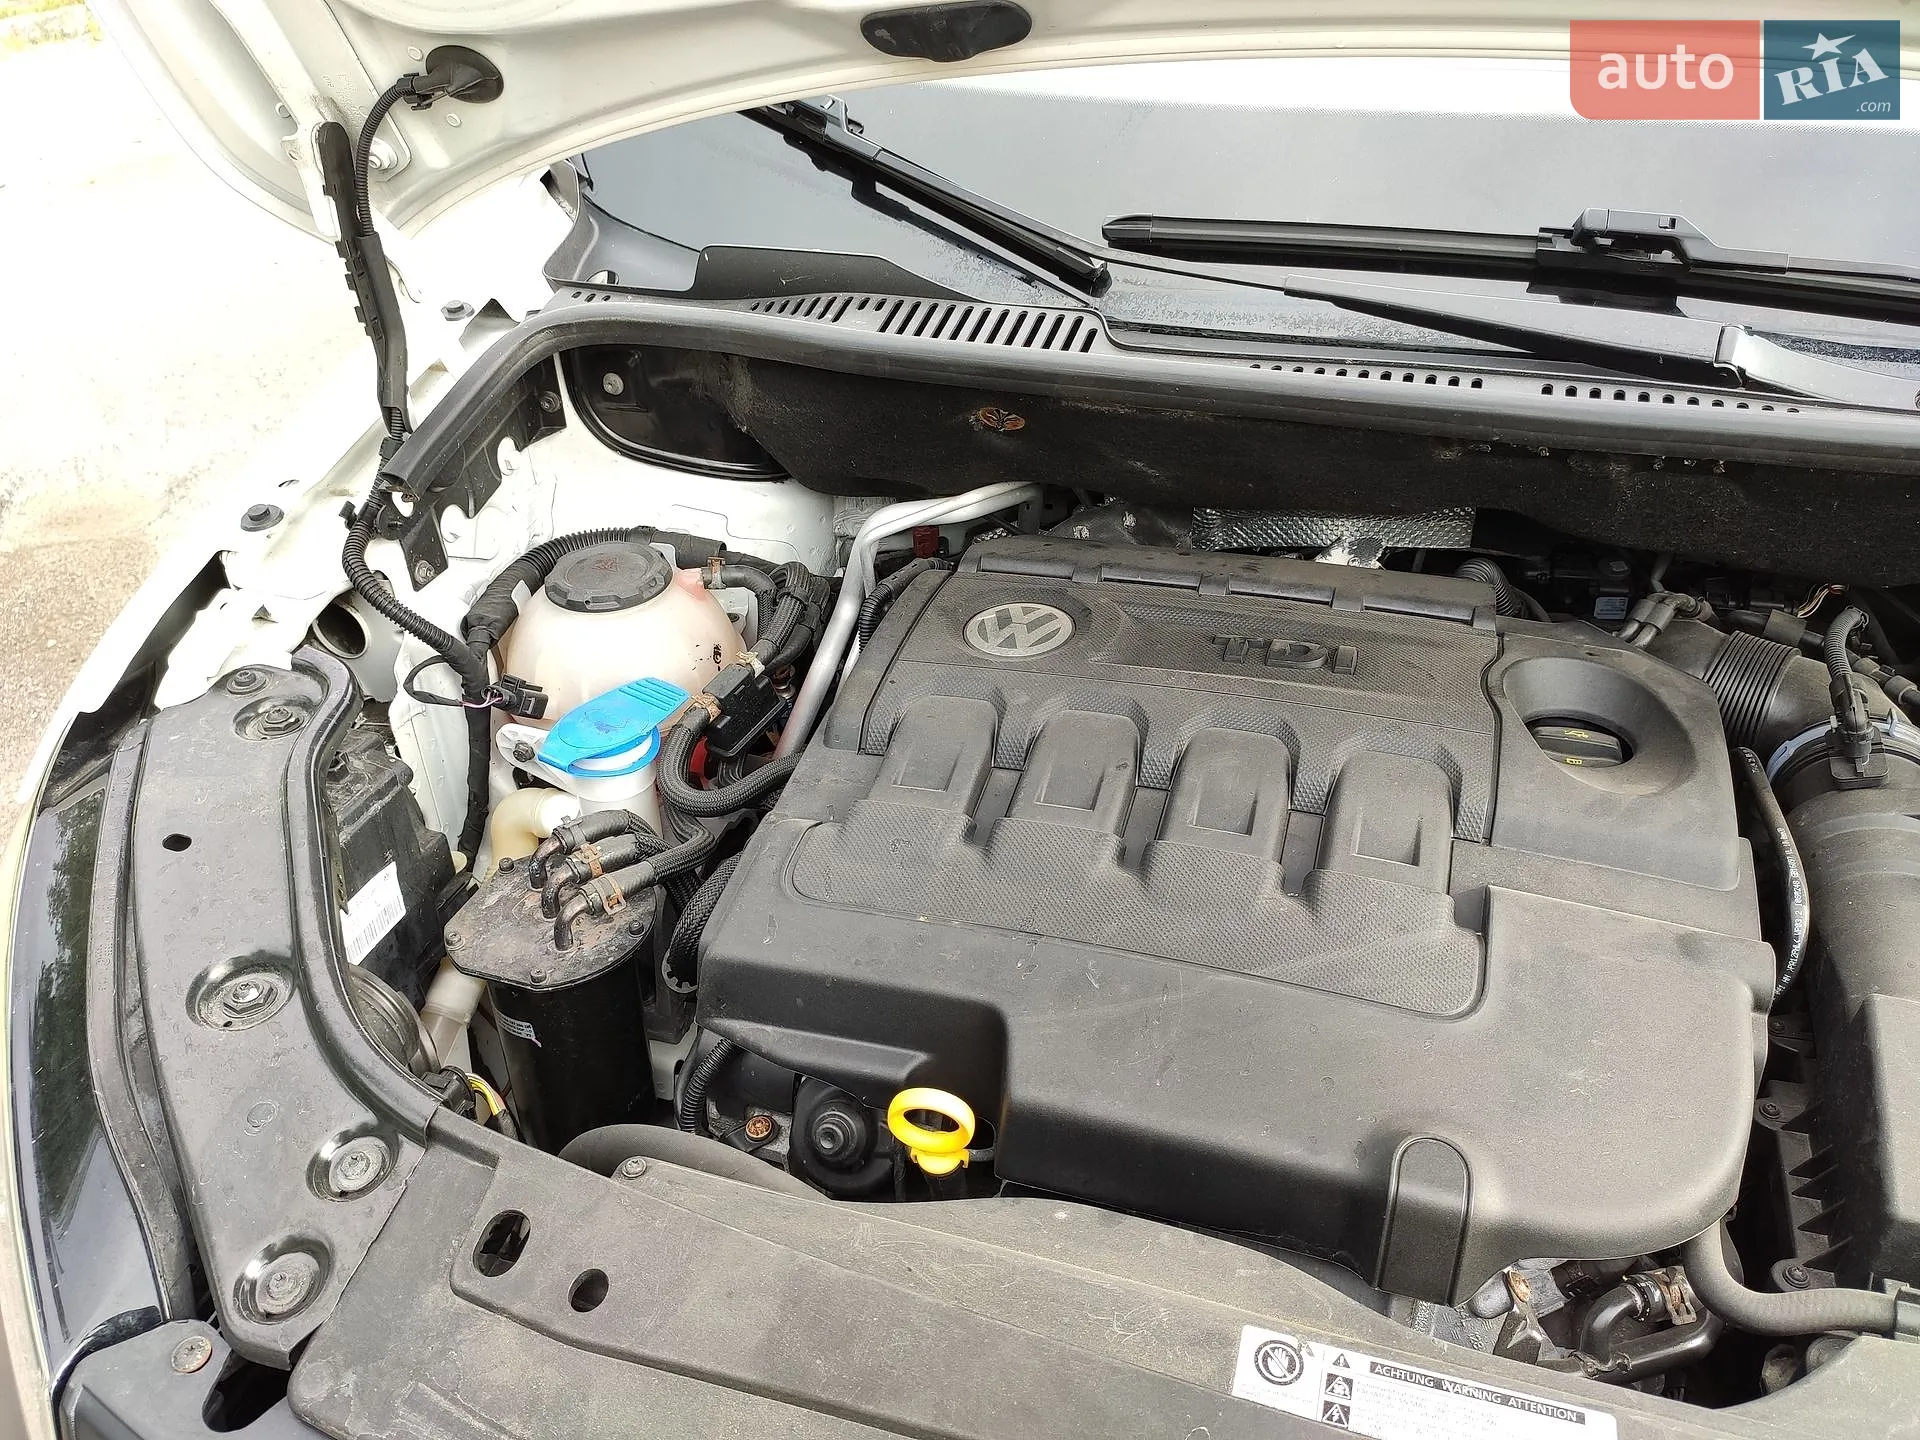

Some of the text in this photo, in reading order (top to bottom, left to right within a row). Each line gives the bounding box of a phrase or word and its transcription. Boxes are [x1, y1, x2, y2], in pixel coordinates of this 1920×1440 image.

[1211, 634, 1359, 676] TDI
[1374, 1364, 1434, 1388] ACHTUNG
[1441, 1380, 1501, 1404] WARNING
[1508, 1396, 1578, 1422] ATTENTION
